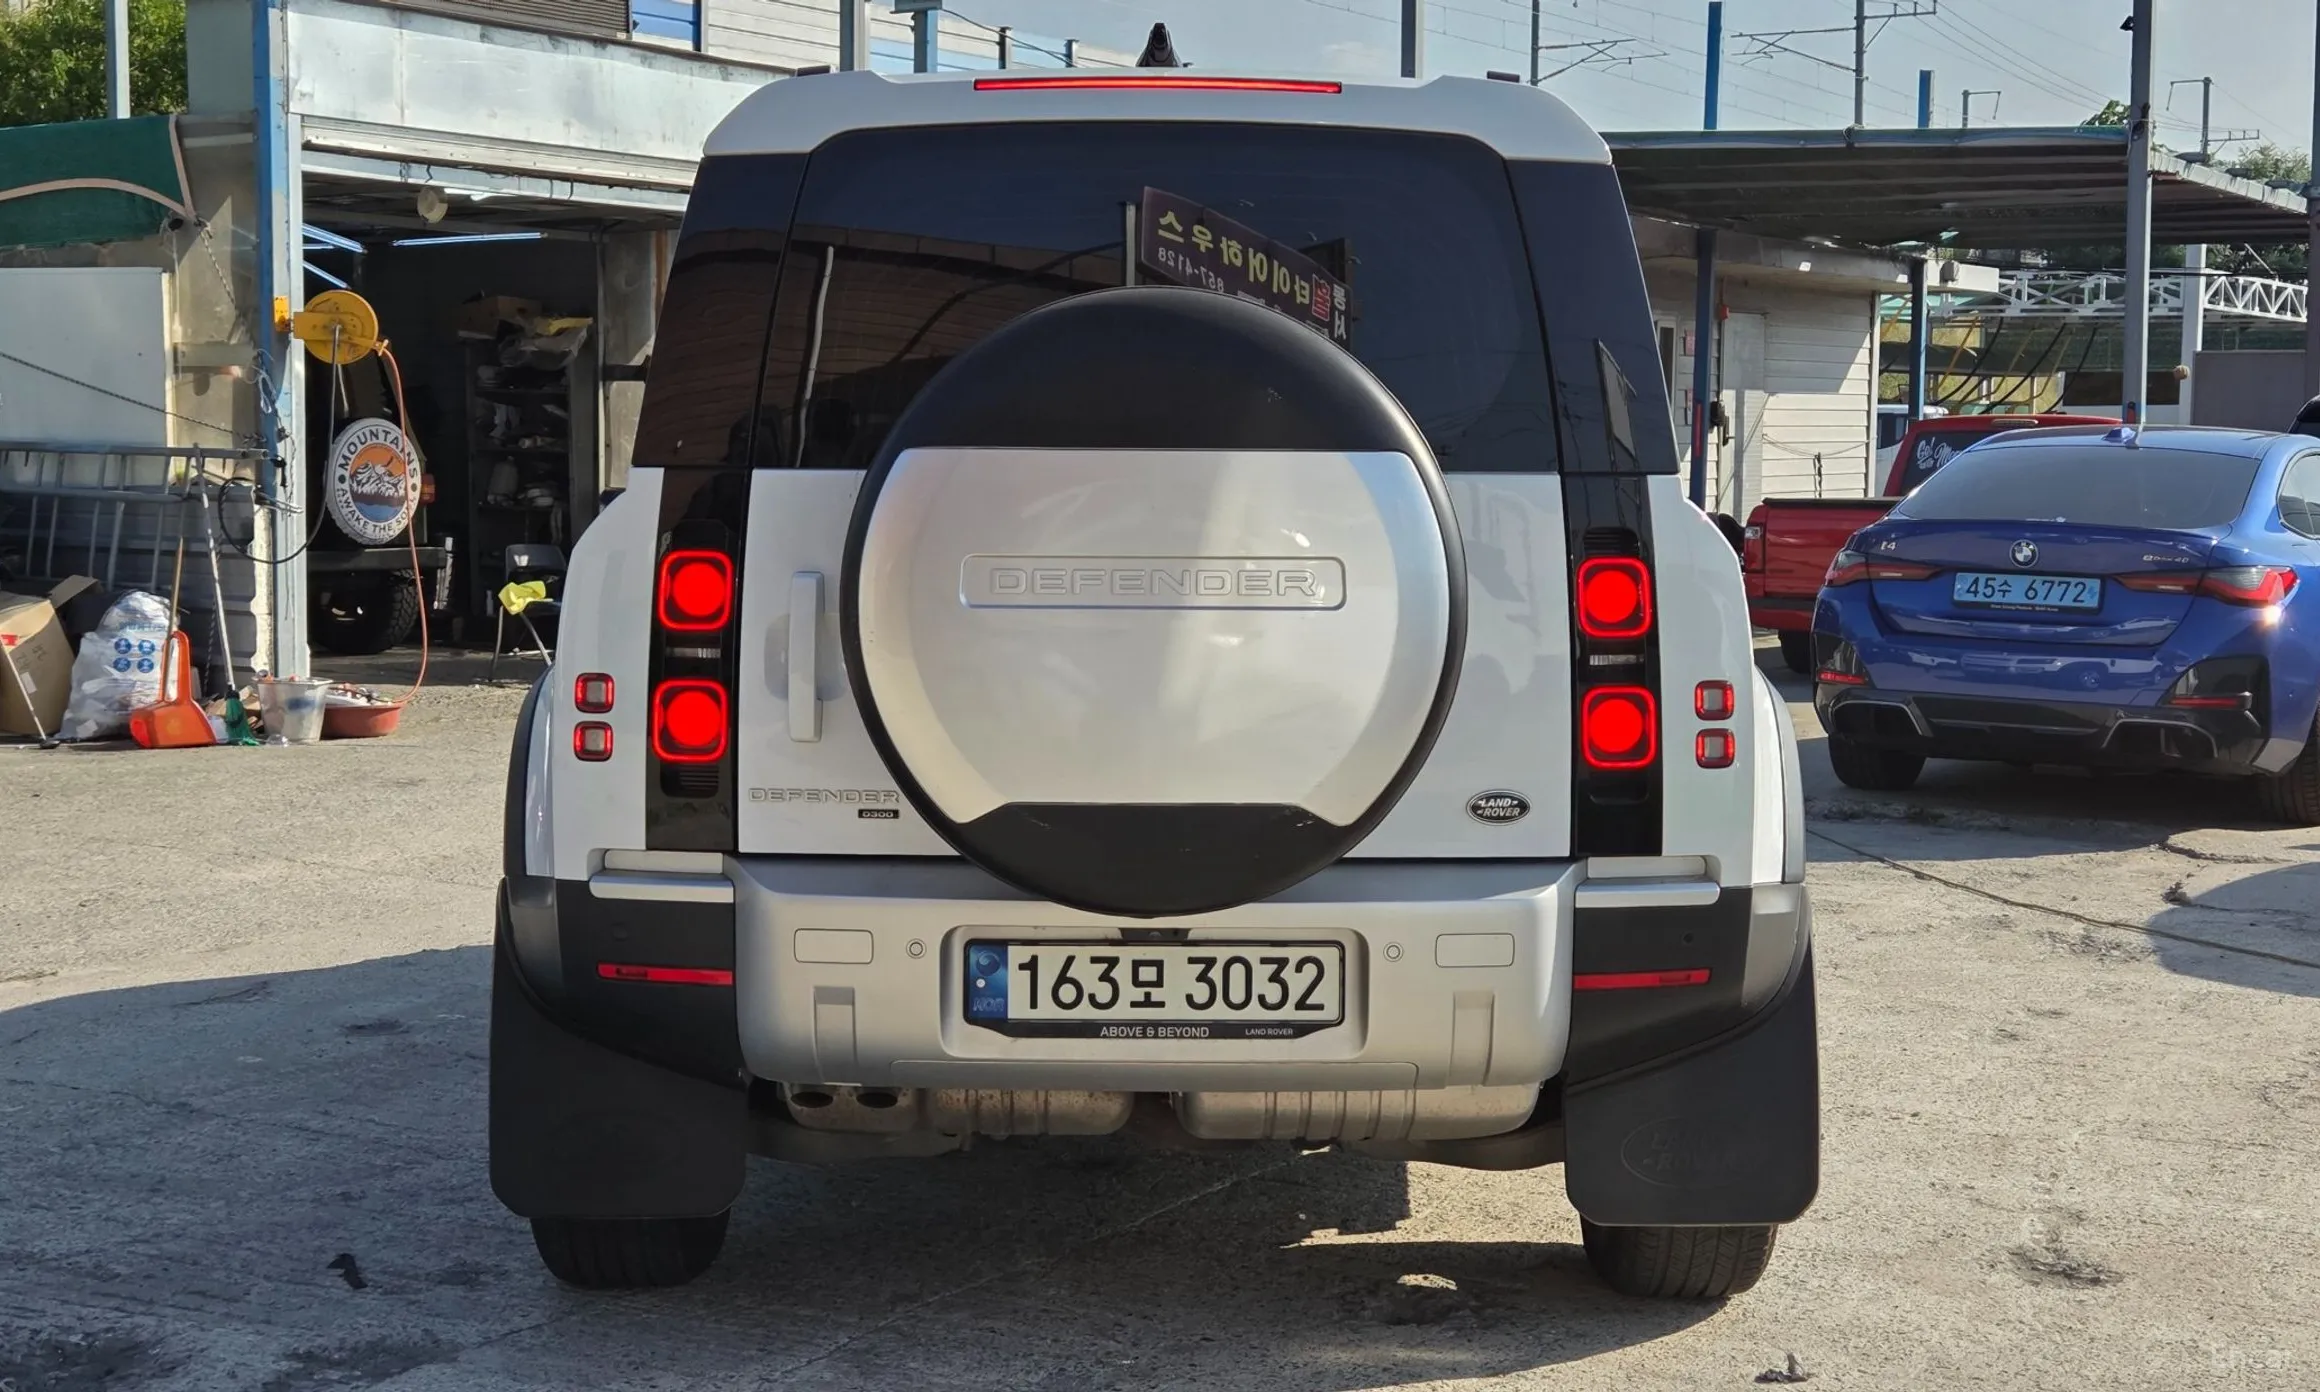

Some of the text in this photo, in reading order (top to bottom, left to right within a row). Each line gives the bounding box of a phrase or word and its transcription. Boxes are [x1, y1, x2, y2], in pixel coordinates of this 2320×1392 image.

[337, 487, 370, 530] AWAKE
[372, 523, 393, 533] THE
[988, 567, 1316, 597] DEFENDER
[1965, 575, 2087, 603] 45수 6772
[748, 787, 900, 803] DEFENDER
[1480, 798, 1511, 807] LAND
[1482, 807, 1520, 817] ROVER
[1017, 954, 1325, 1011] 163모 3032
[1100, 1026, 1143, 1038] ABOVE
[1158, 1026, 1209, 1038] BEYOND
[1245, 1028, 1265, 1036] LAND
[1267, 1028, 1293, 1036] ROVER
